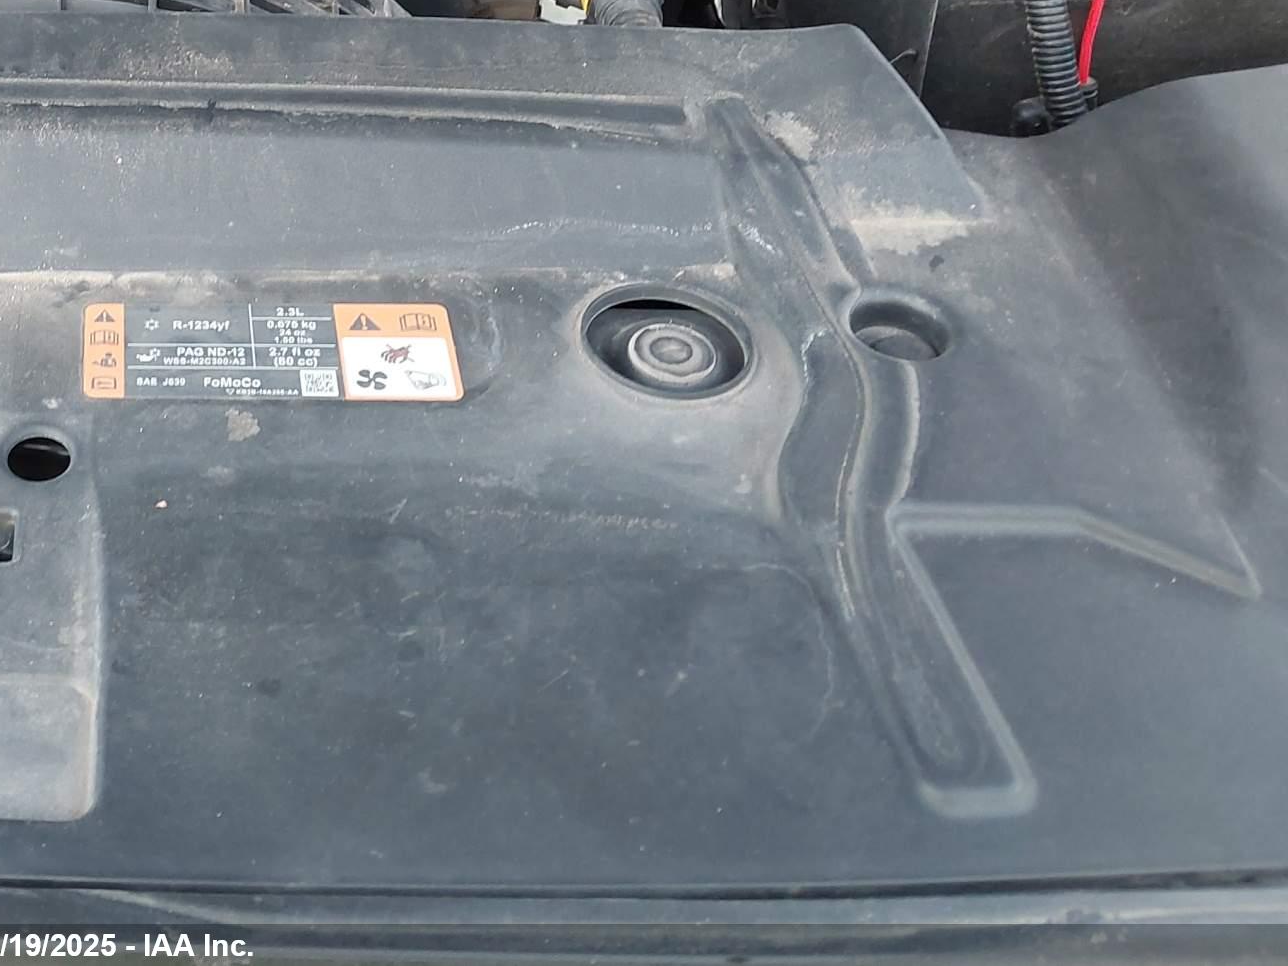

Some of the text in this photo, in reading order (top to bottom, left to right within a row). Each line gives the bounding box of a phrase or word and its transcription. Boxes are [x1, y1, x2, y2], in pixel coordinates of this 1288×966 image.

[276, 307, 305, 317] 2.3L
[172, 320, 231, 332] R-1234yf
[300, 320, 317, 331] kg
[176, 346, 246, 357] PAG ND-12
[268, 347, 321, 357] 2.7 fl oz
[297, 356, 318, 368] cc)
[136, 377, 158, 386] SAE
[203, 377, 262, 388] FoMoCo
